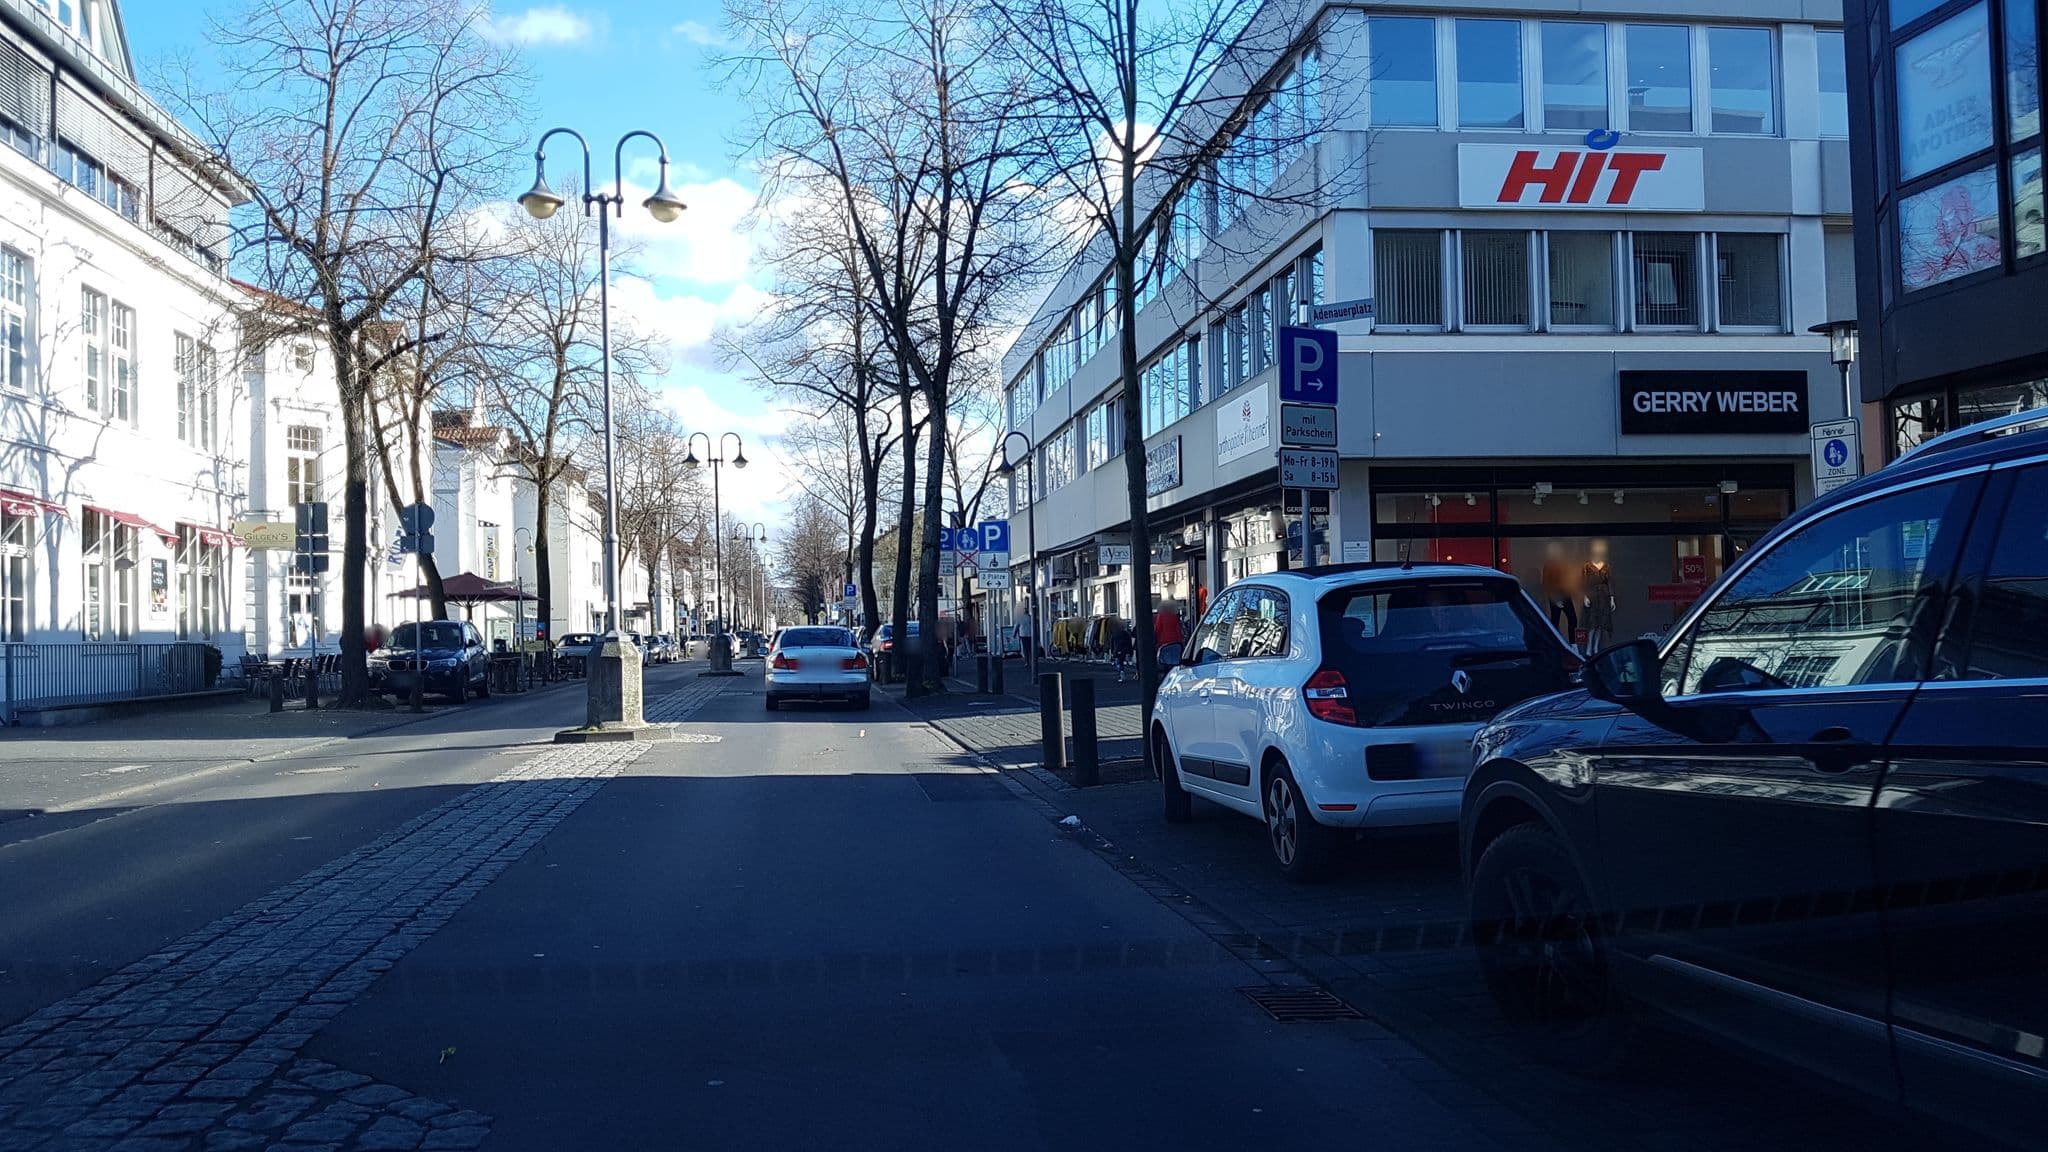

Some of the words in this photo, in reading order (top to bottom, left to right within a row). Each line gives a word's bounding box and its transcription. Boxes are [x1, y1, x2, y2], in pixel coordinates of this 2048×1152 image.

[1313, 303, 1372, 320] Adenauerplatz
[1294, 337, 1323, 392] P
[1632, 391, 1711, 413] GERRY
[1716, 391, 1799, 413] WEBER
[1302, 415, 1316, 425] mit
[1286, 426, 1333, 438] Parkschein
[1284, 470, 1294, 481] Sa
[1828, 467, 1847, 475] ZONE
[985, 525, 1001, 550] P
[1428, 700, 1495, 711] TWINGO
